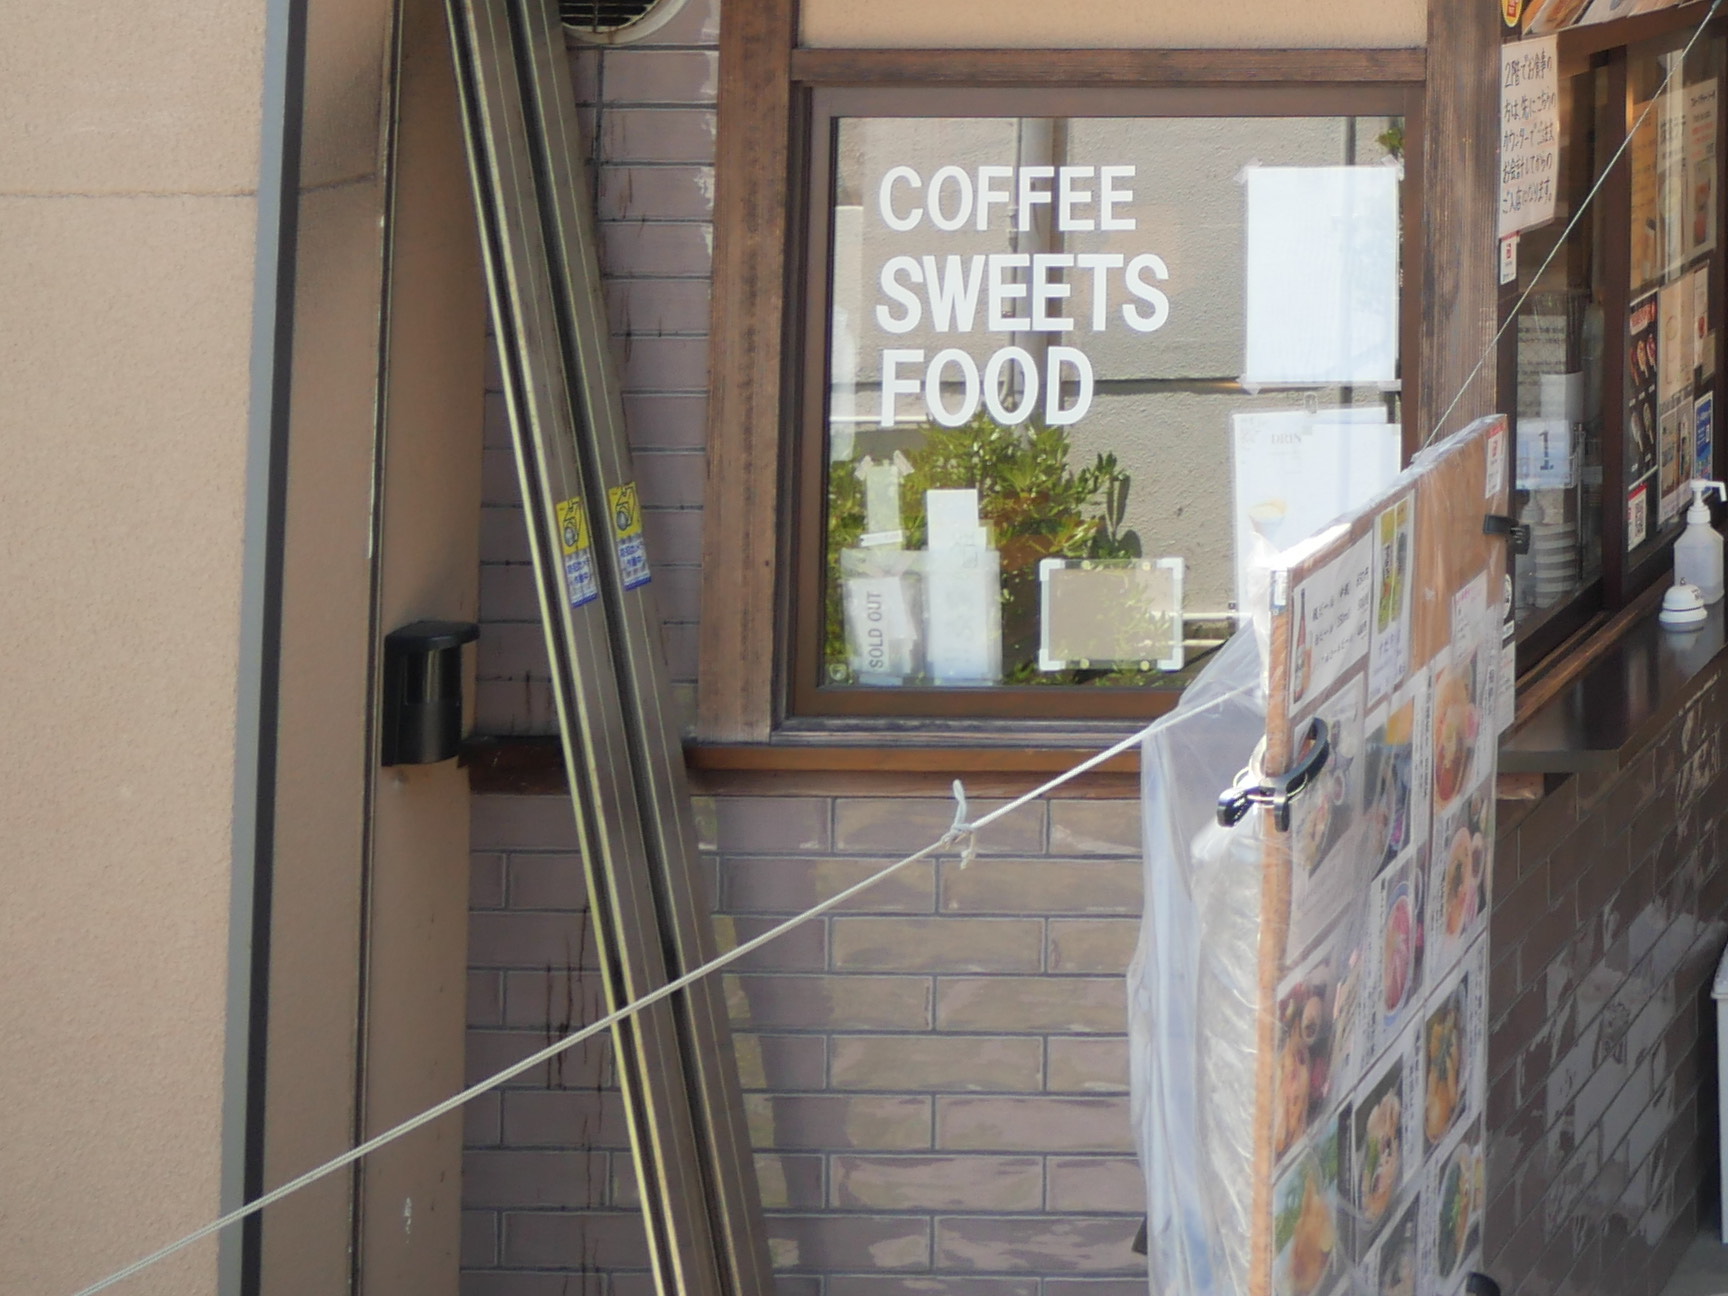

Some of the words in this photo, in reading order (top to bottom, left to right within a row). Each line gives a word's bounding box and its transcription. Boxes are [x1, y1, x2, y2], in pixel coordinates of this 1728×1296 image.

[879, 166, 1136, 231] COFFEE
[876, 253, 1169, 332] SWEETS
[879, 346, 1095, 427] FOOD
[867, 592, 883, 621] OUT
[870, 629, 883, 669] SOLD
